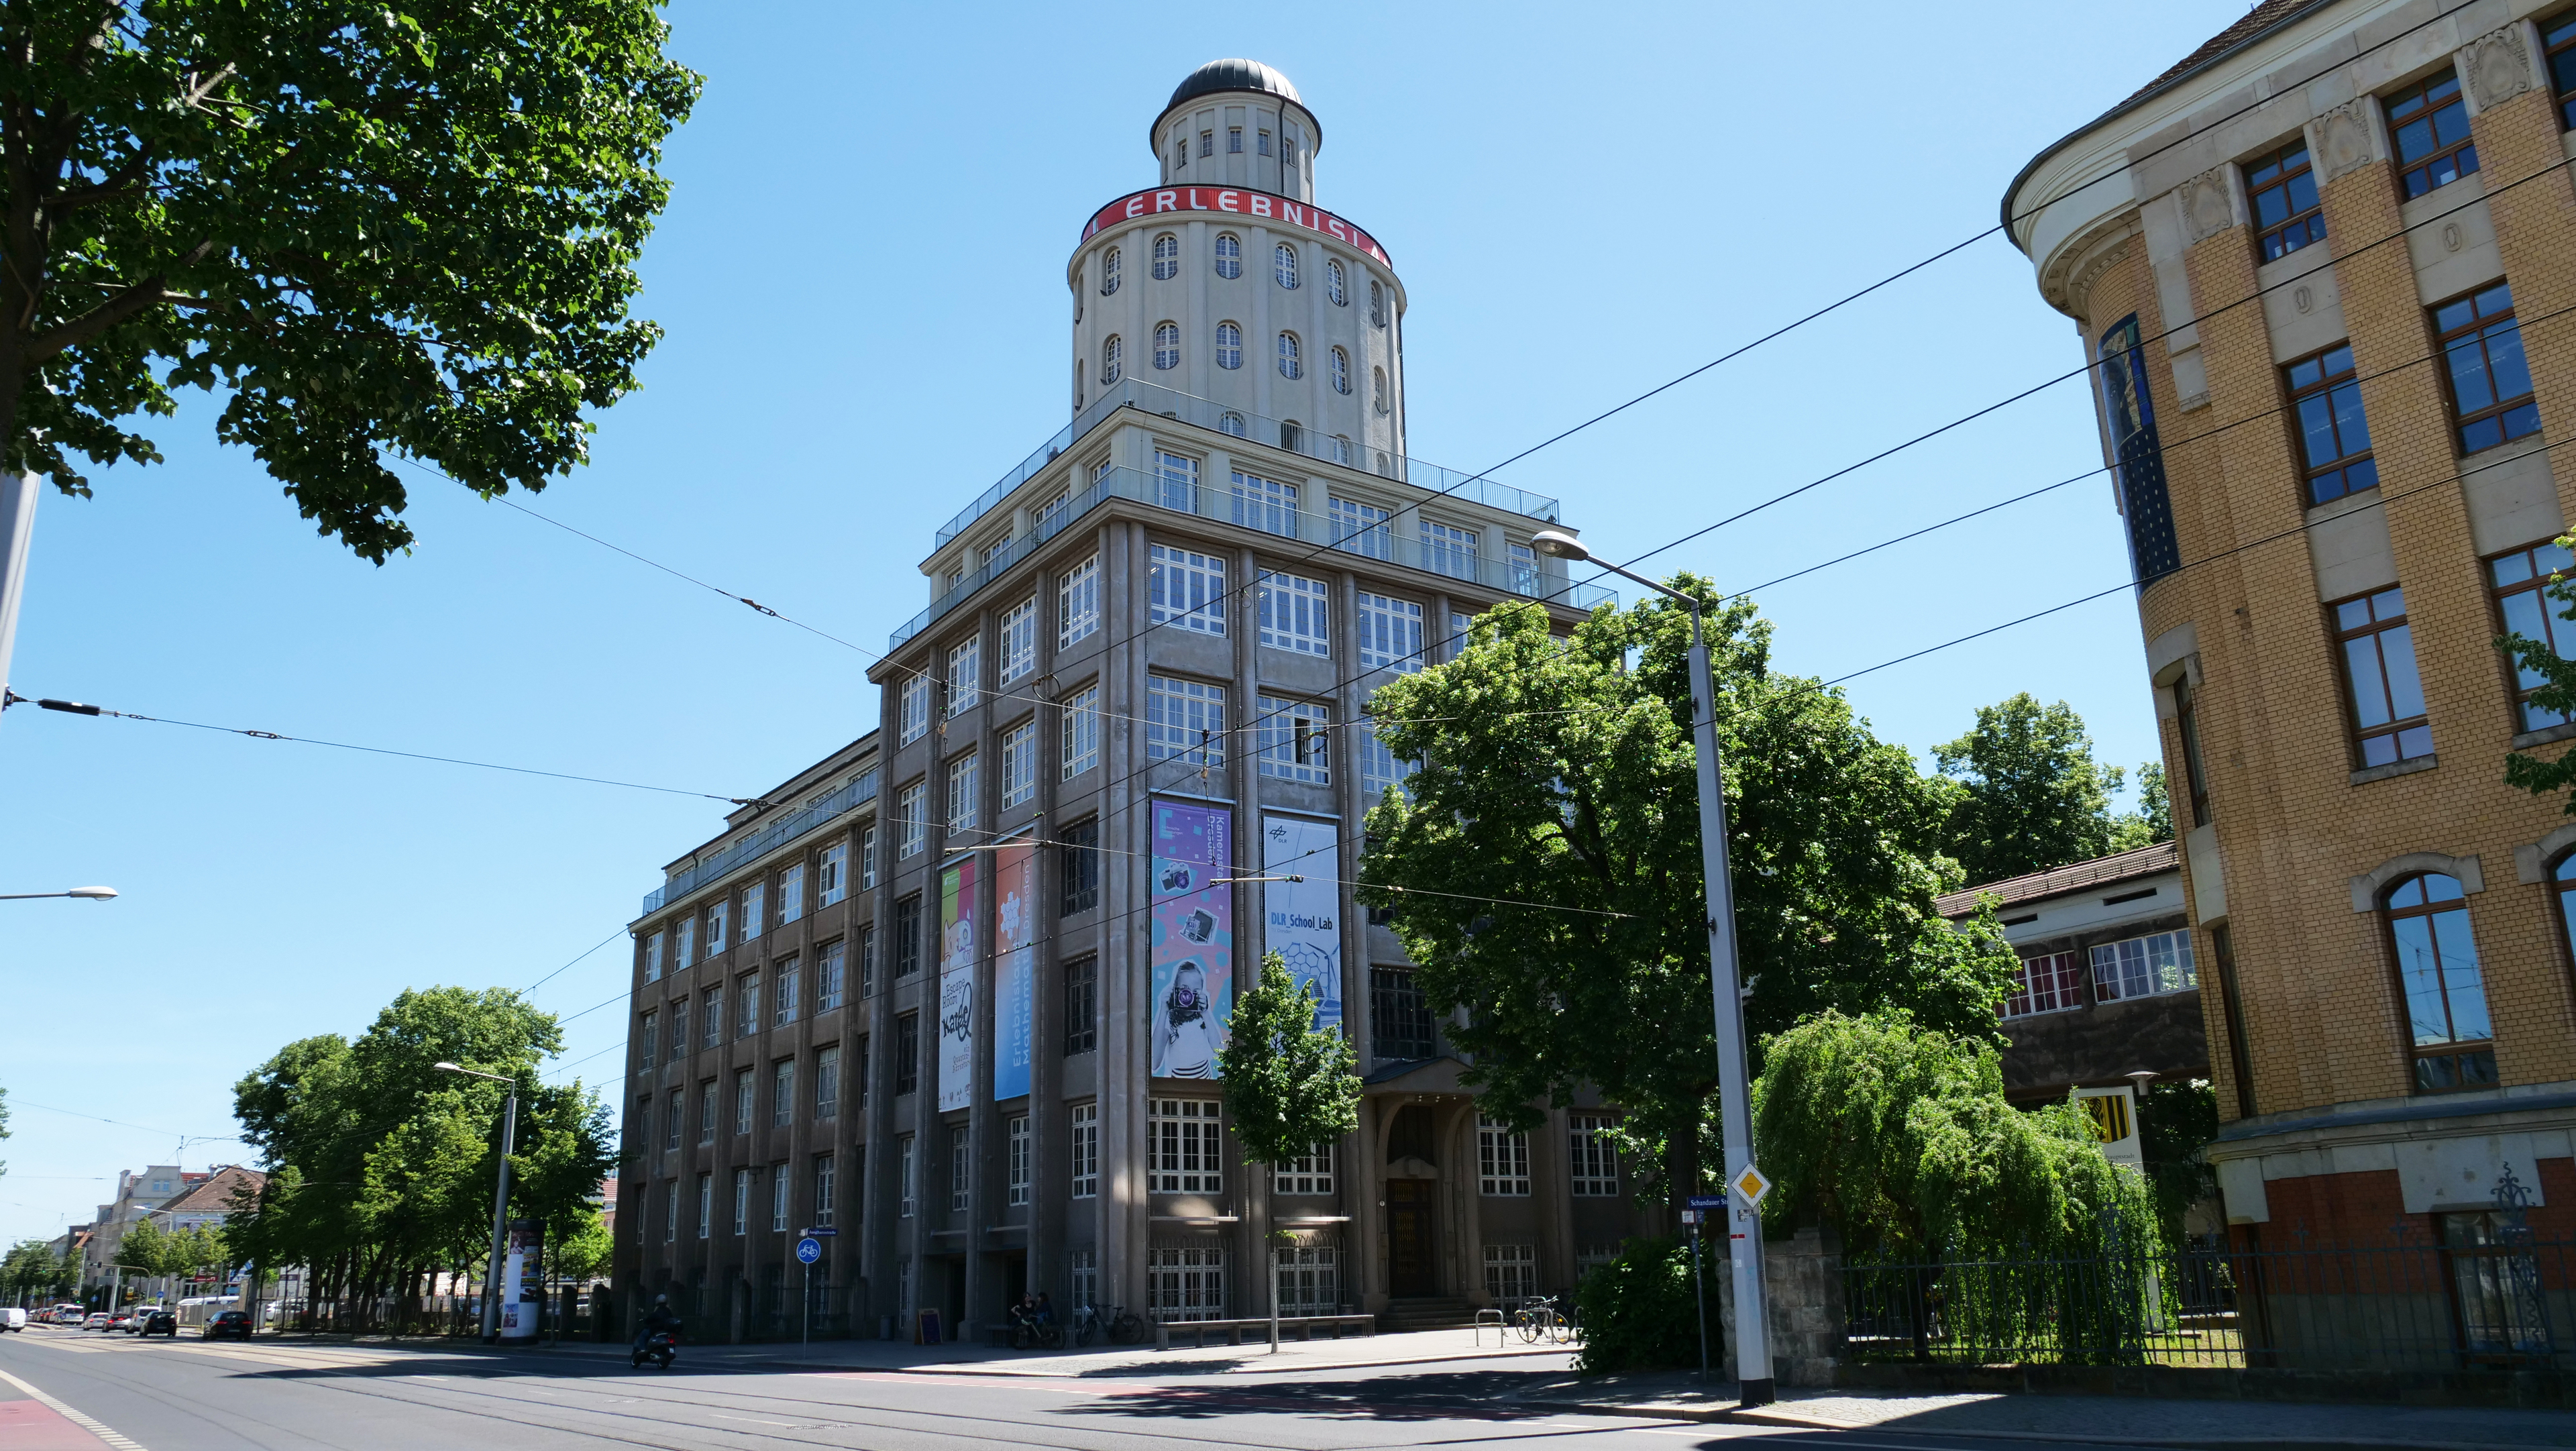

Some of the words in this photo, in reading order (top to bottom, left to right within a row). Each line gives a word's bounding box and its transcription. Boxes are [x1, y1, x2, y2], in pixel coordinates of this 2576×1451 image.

[1271, 912, 1332, 931] DLR_School_Lab
[946, 978, 965, 997] Escape
[943, 995, 957, 1009] Room
